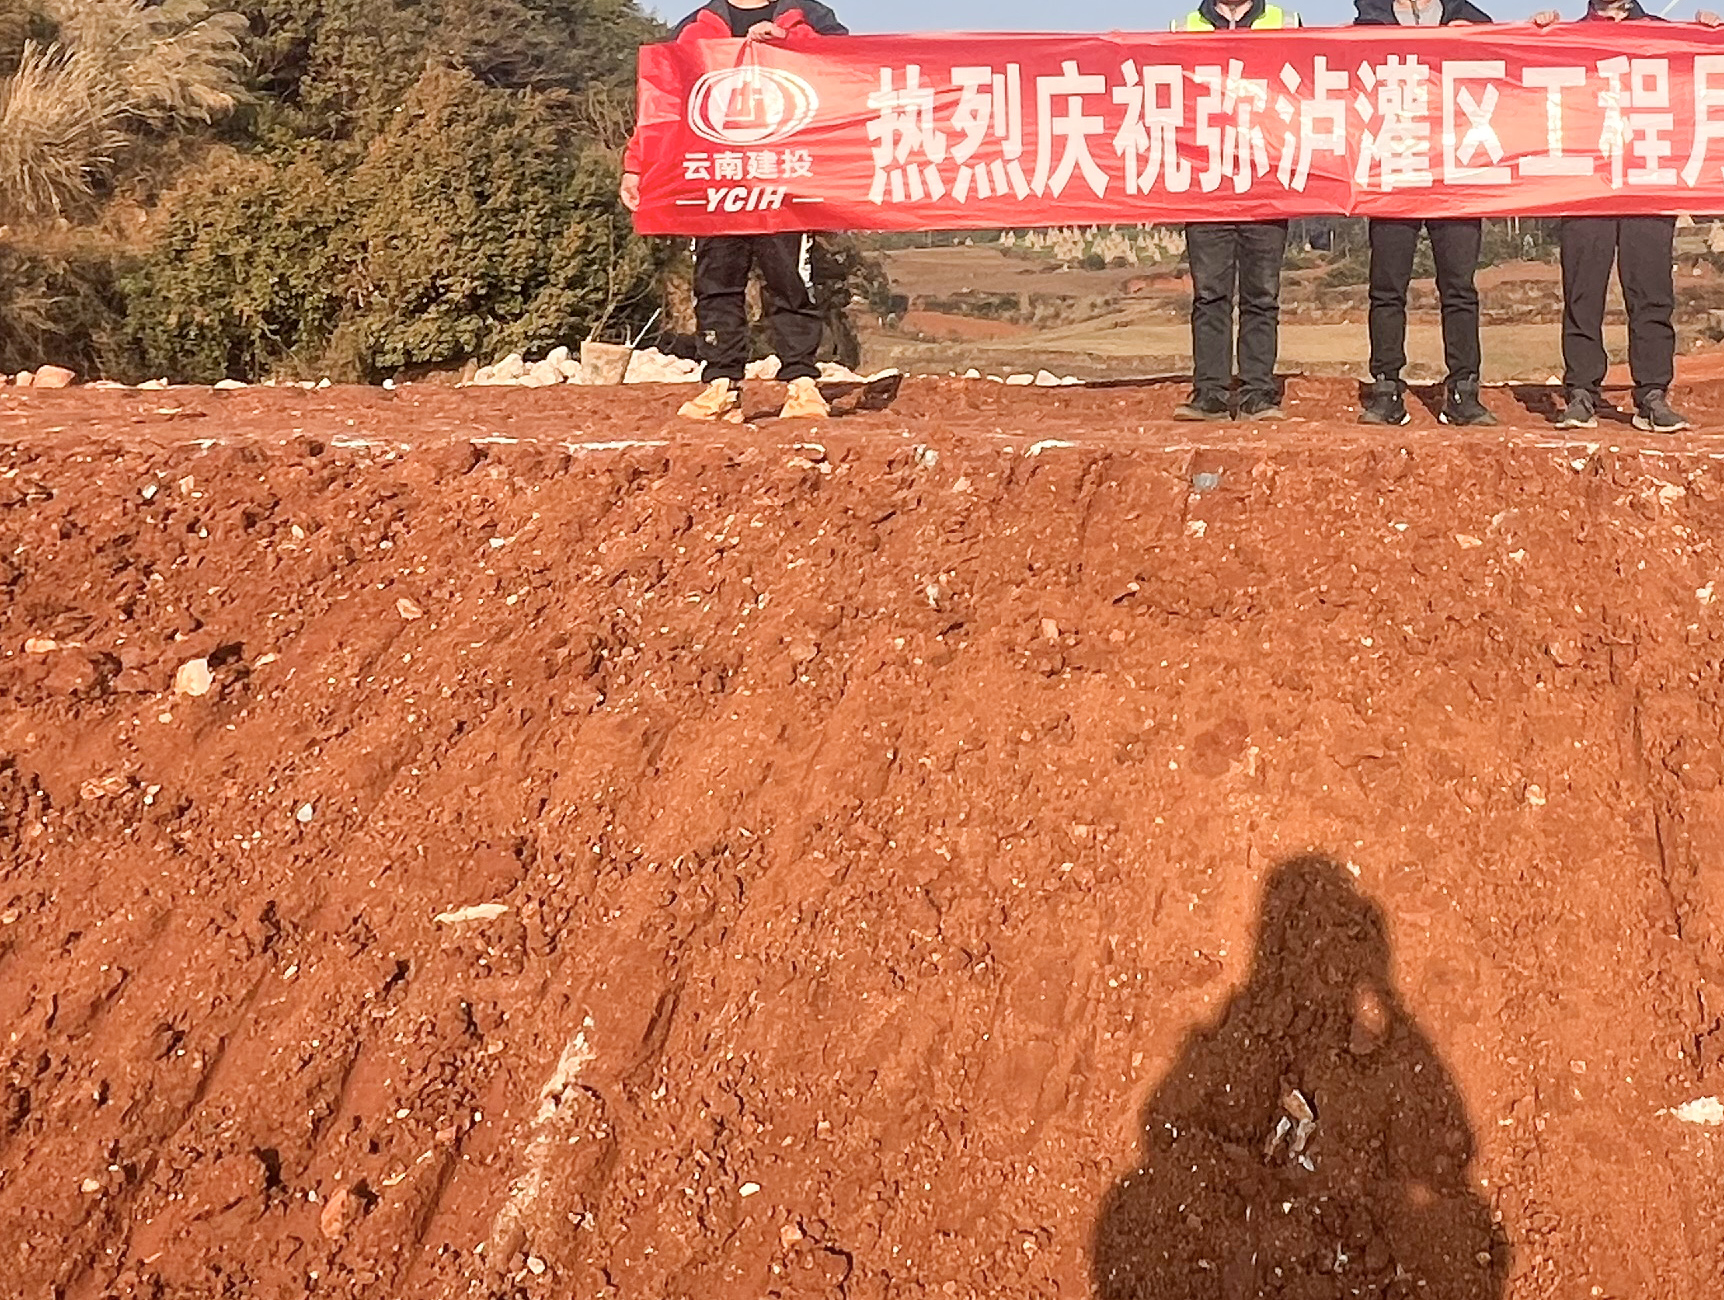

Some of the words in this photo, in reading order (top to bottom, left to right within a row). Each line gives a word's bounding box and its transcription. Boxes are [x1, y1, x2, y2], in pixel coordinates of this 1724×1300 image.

[683, 149, 813, 181] 云南建投
[706, 186, 787, 212] YCIH
